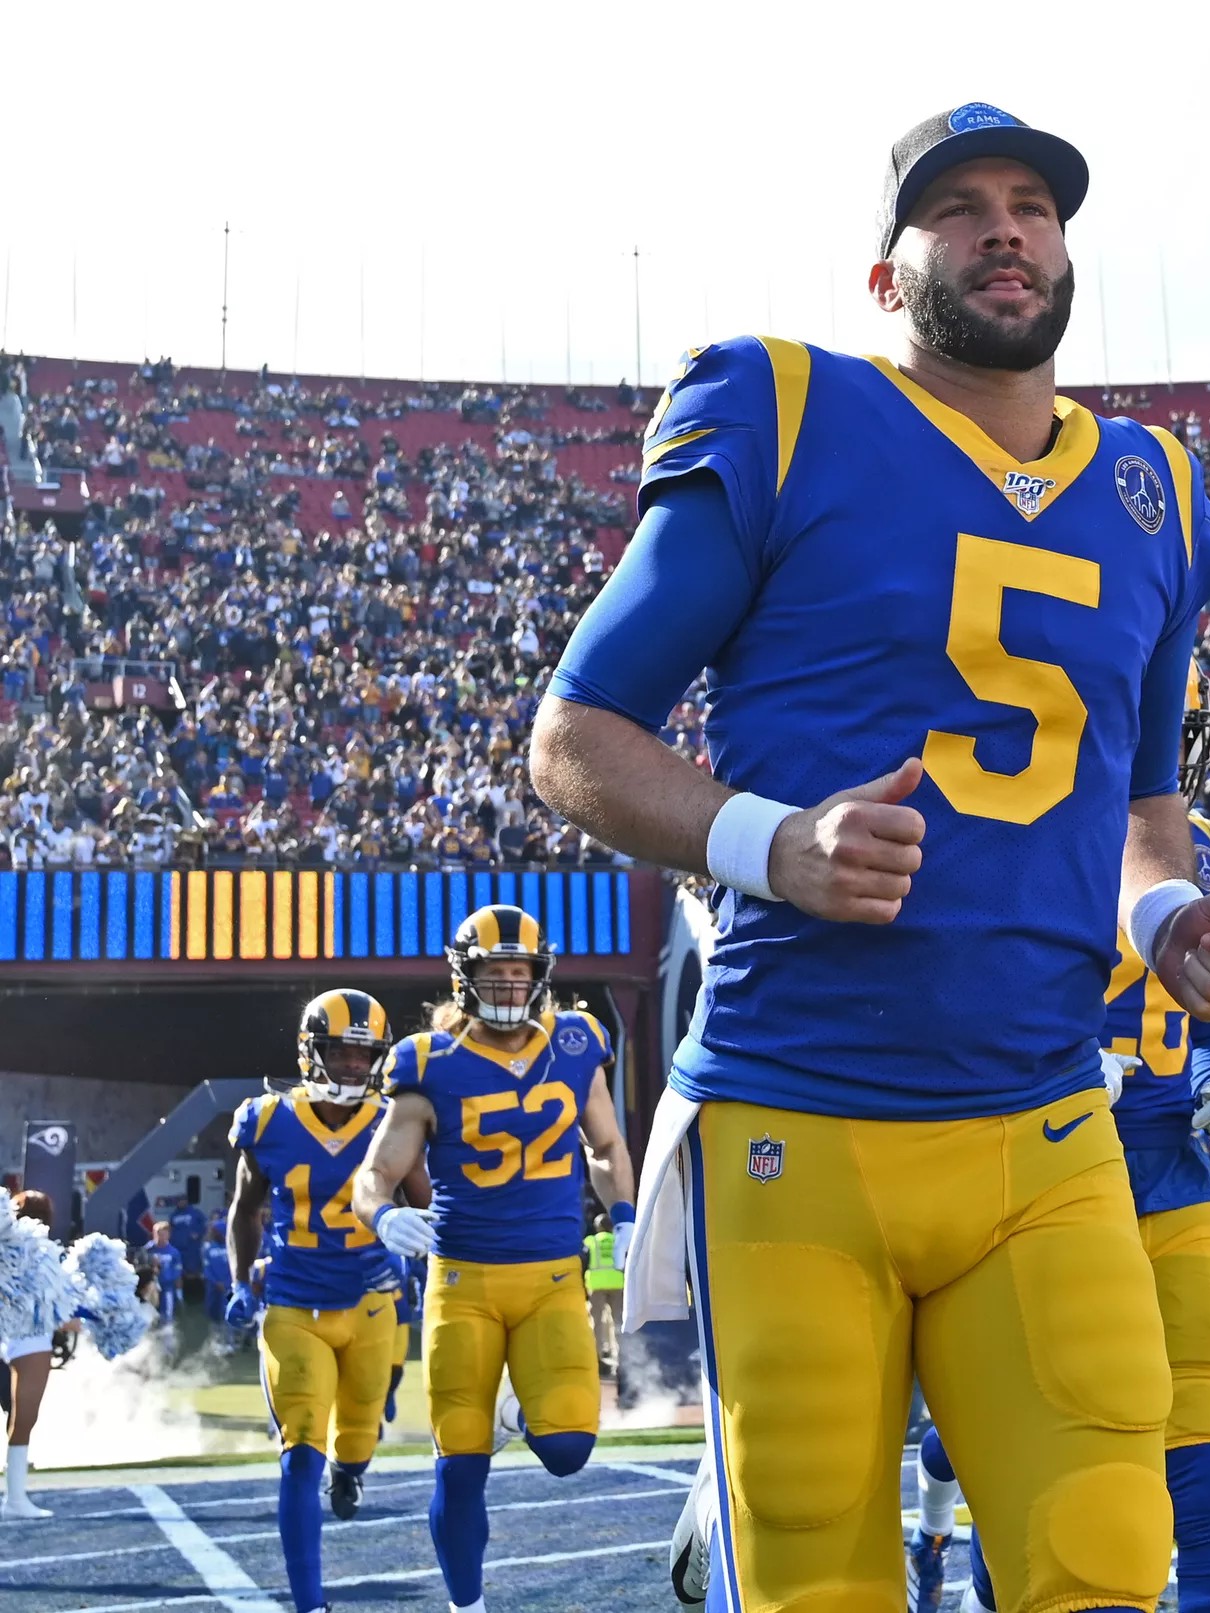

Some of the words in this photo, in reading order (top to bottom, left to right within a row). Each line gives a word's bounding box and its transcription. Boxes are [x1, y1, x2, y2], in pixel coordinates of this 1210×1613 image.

[966, 115, 1001, 124] RAMS
[1021, 498, 1037, 510] NFL
[921, 532, 1101, 826] 5
[132, 683, 147, 699] 12
[460, 1081, 578, 1188] 52
[752, 1156, 778, 1175] NFL
[284, 1164, 378, 1248] 14
